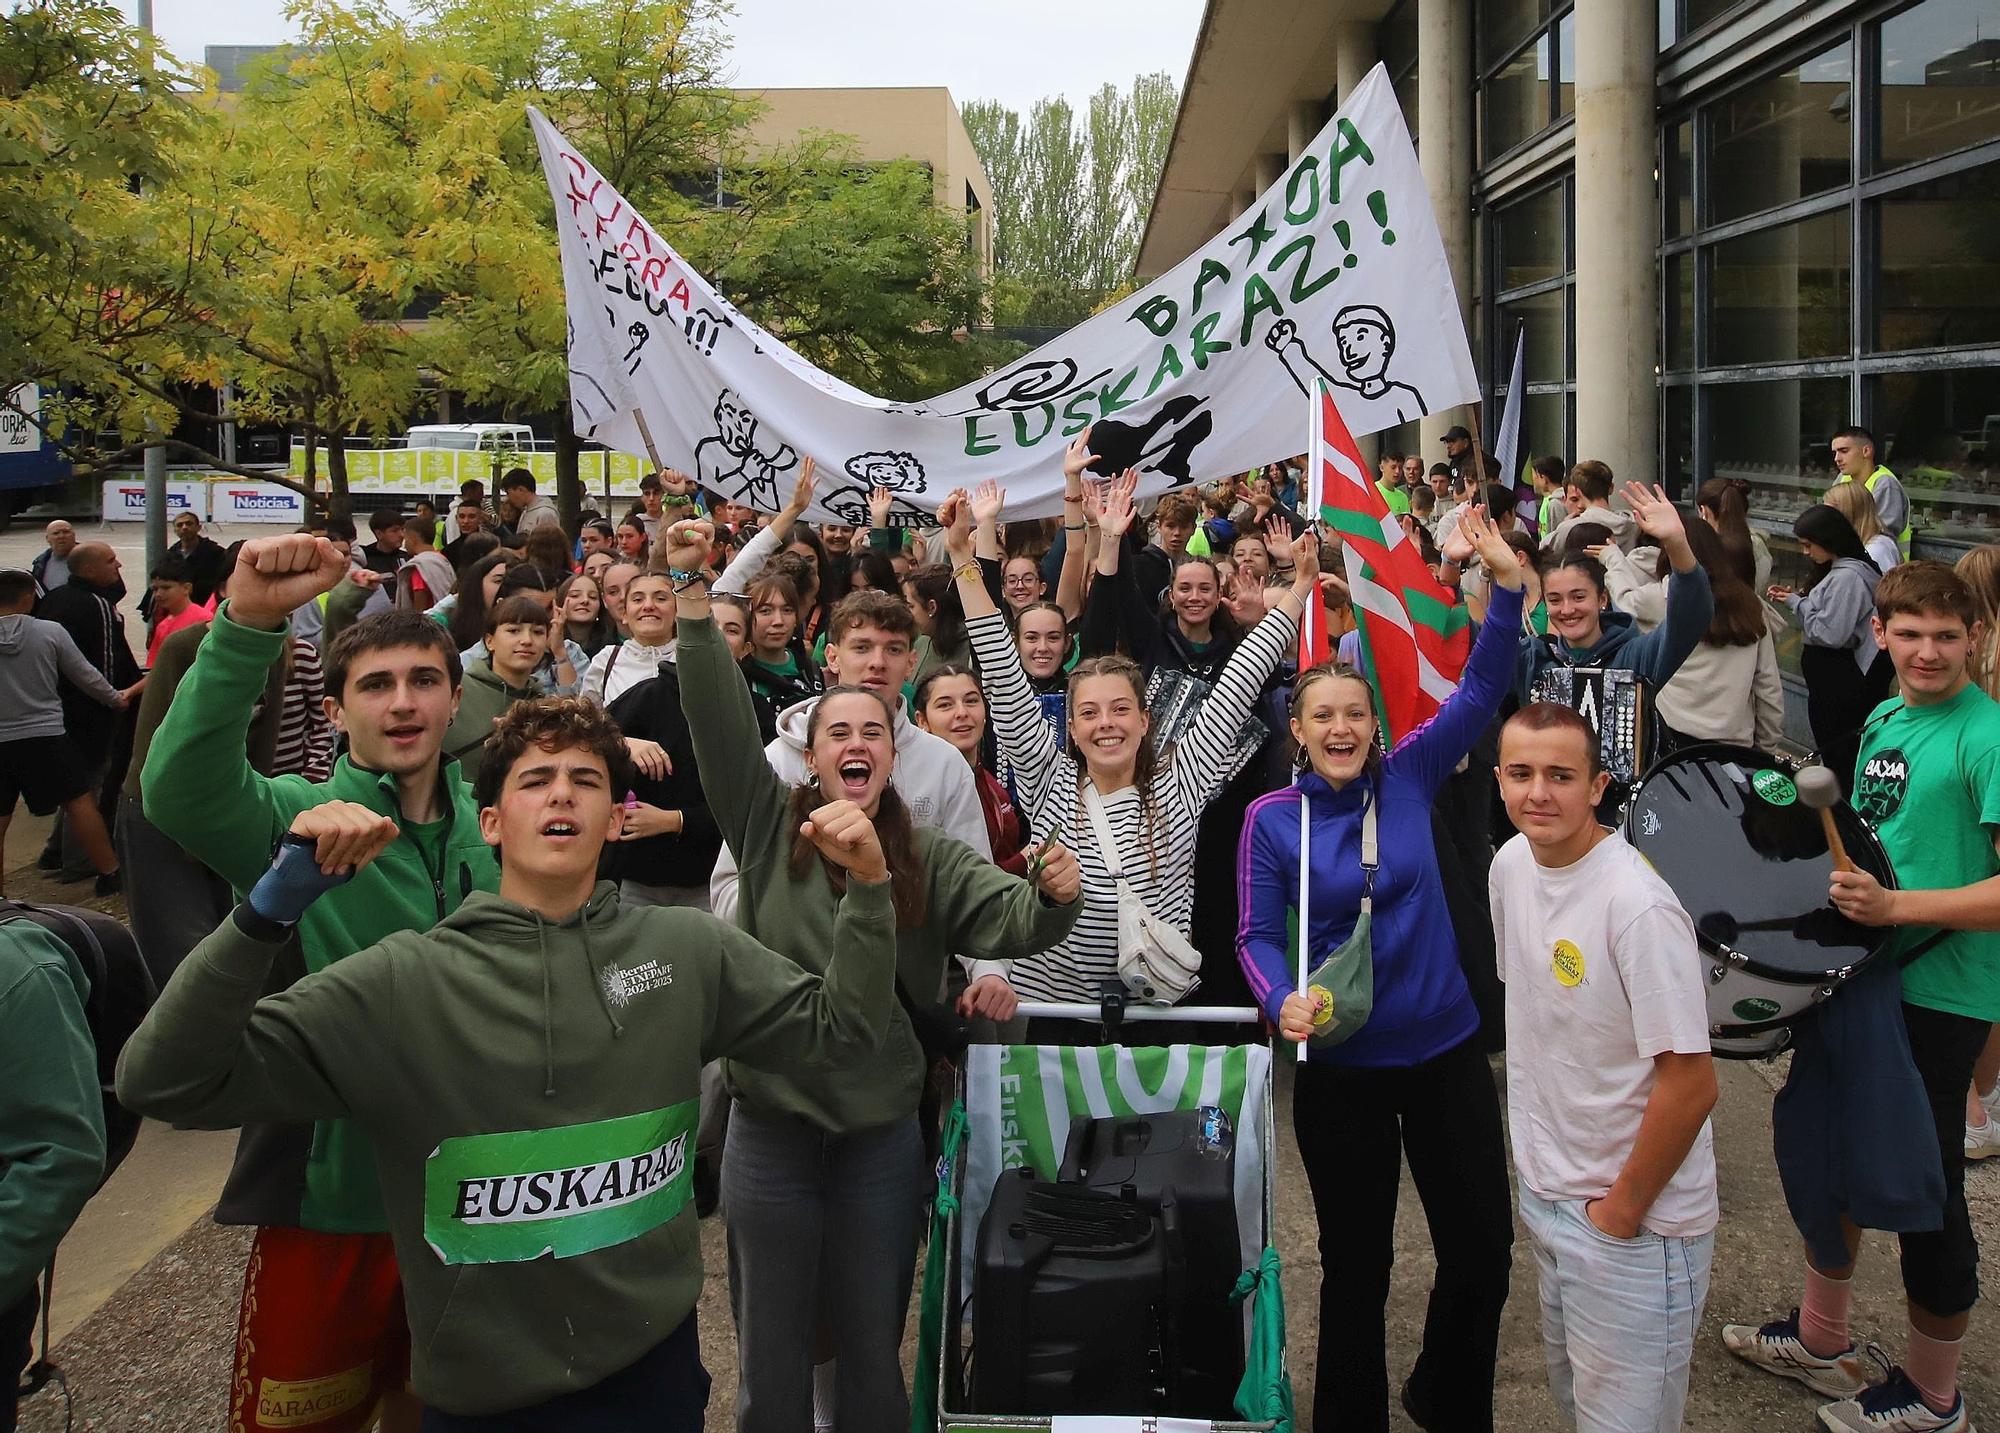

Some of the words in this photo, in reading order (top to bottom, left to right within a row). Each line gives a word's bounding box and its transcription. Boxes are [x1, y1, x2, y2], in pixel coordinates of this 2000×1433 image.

[1127, 117, 1375, 338] BAXOA
[236, 496, 291, 508] Noticias
[620, 959, 658, 979] Bernat
[625, 974, 673, 997] 2024-2025
